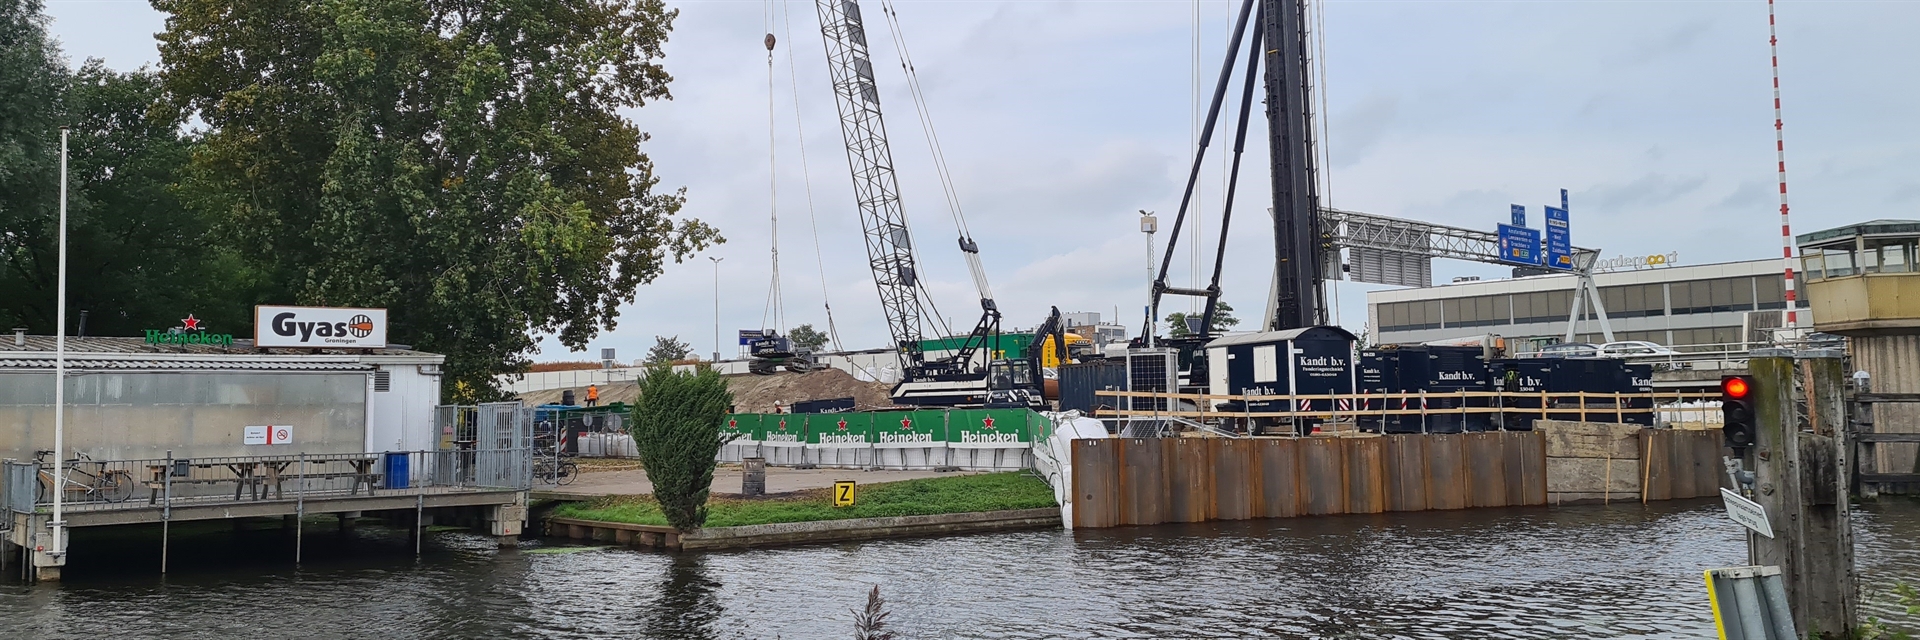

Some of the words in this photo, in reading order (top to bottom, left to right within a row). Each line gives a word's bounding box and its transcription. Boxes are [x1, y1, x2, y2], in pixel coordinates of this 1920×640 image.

[1594, 251, 1678, 270] oorderpoort
[272, 311, 348, 343] Gyas
[145, 328, 233, 345] Heineken
[324, 337, 357, 345] Groningen
[1300, 356, 1327, 366] Kandt
[1331, 356, 1346, 366] b.v.
[1438, 372, 1461, 380] Kandt
[1462, 371, 1475, 380] b.v.
[1527, 376, 1542, 386] b.v.
[1264, 386, 1276, 395] b.v.
[718, 430, 752, 441] eineken
[766, 431, 797, 442] Heineken
[819, 432, 866, 444] Heineken
[879, 430, 932, 444] Heineken
[960, 430, 1018, 443] Heineken
[840, 486, 850, 501] Z
